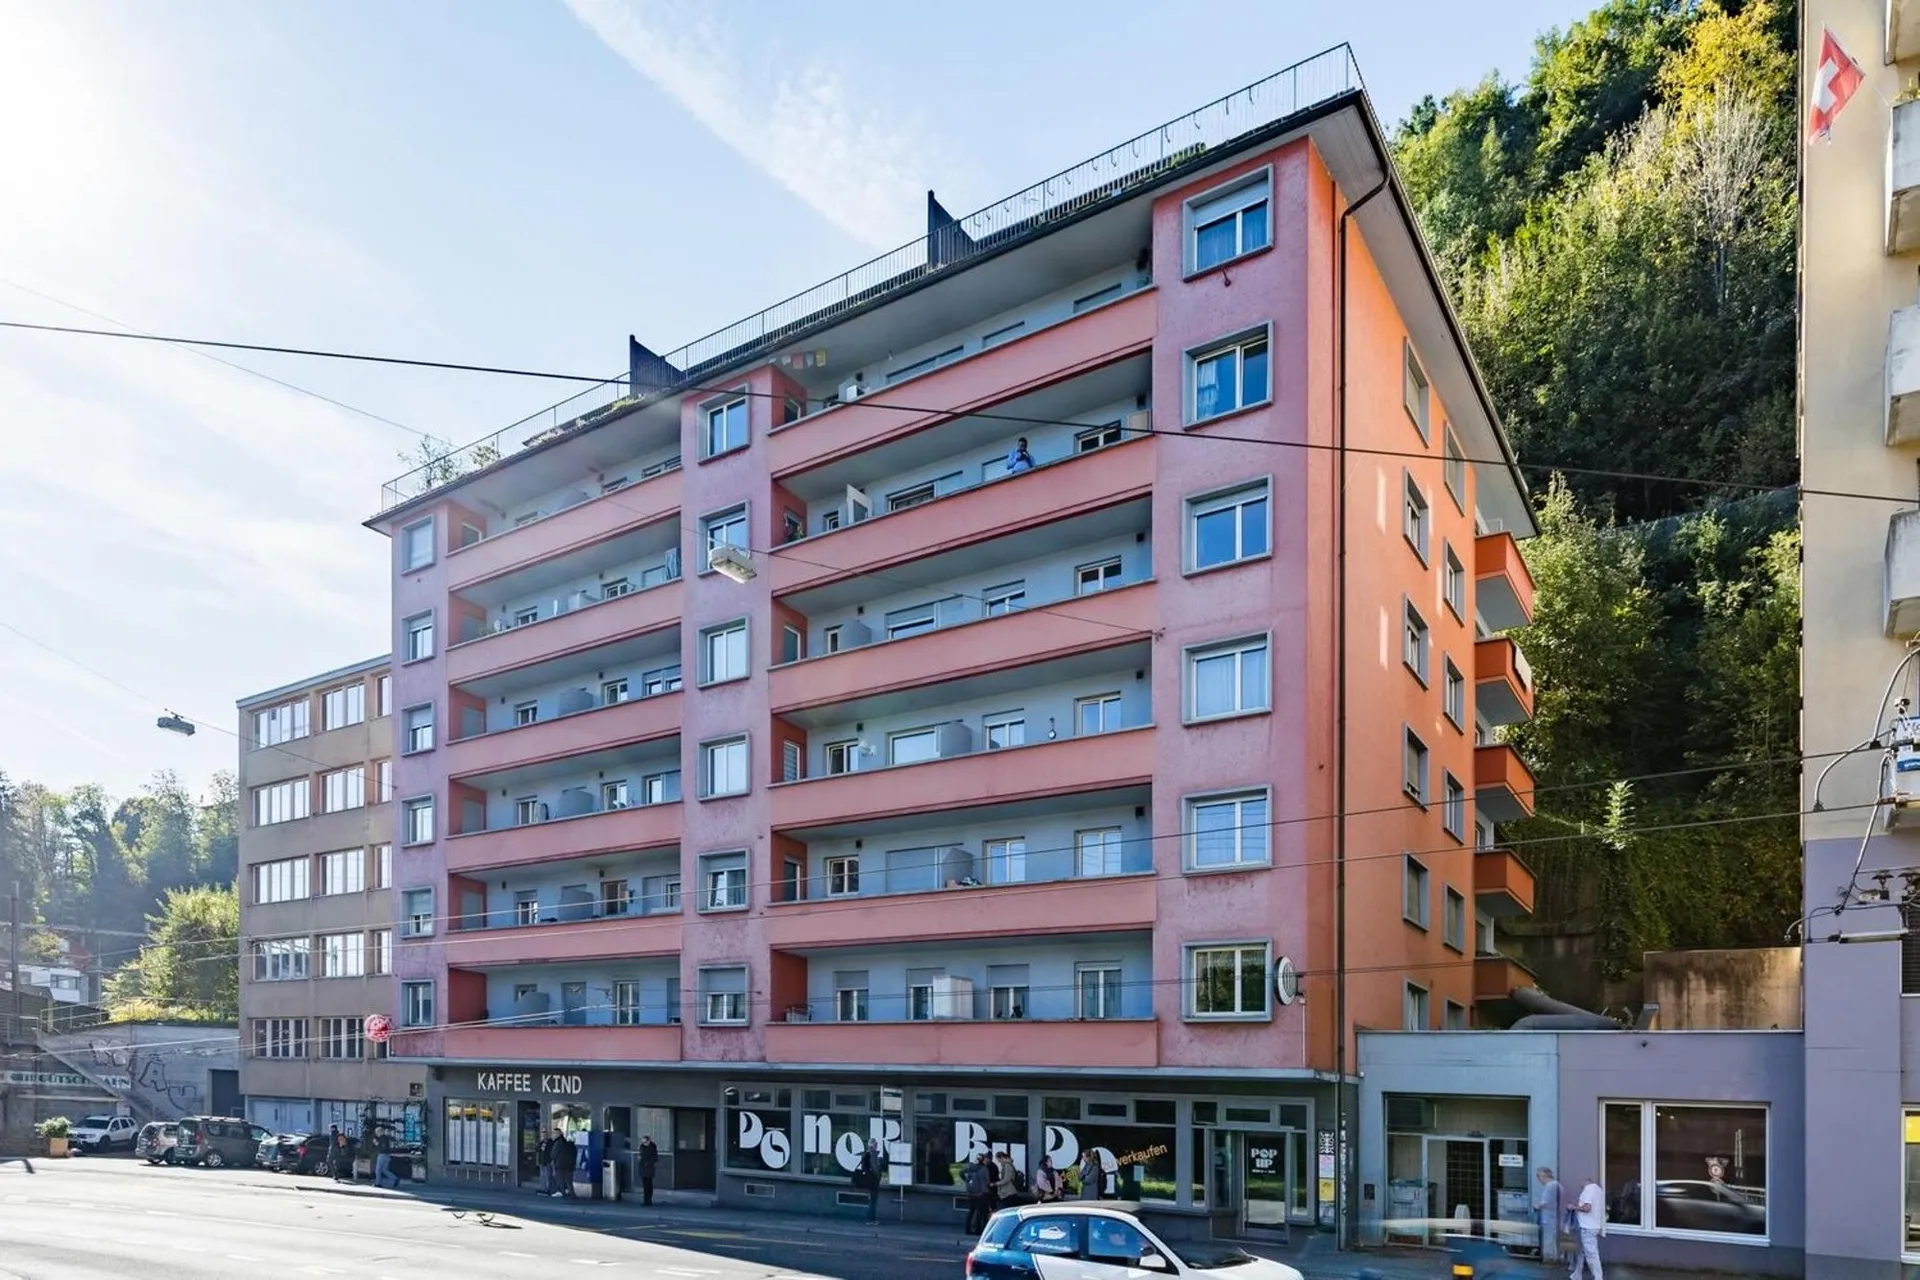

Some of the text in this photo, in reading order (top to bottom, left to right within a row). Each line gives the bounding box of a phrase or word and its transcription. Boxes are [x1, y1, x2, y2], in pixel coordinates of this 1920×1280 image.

[477, 1073, 582, 1095] KAFFEE KIND
[1117, 1143, 1168, 1167] verkaufen
[1251, 1148, 1277, 1158] POP
[1255, 1158, 1273, 1168] UP
